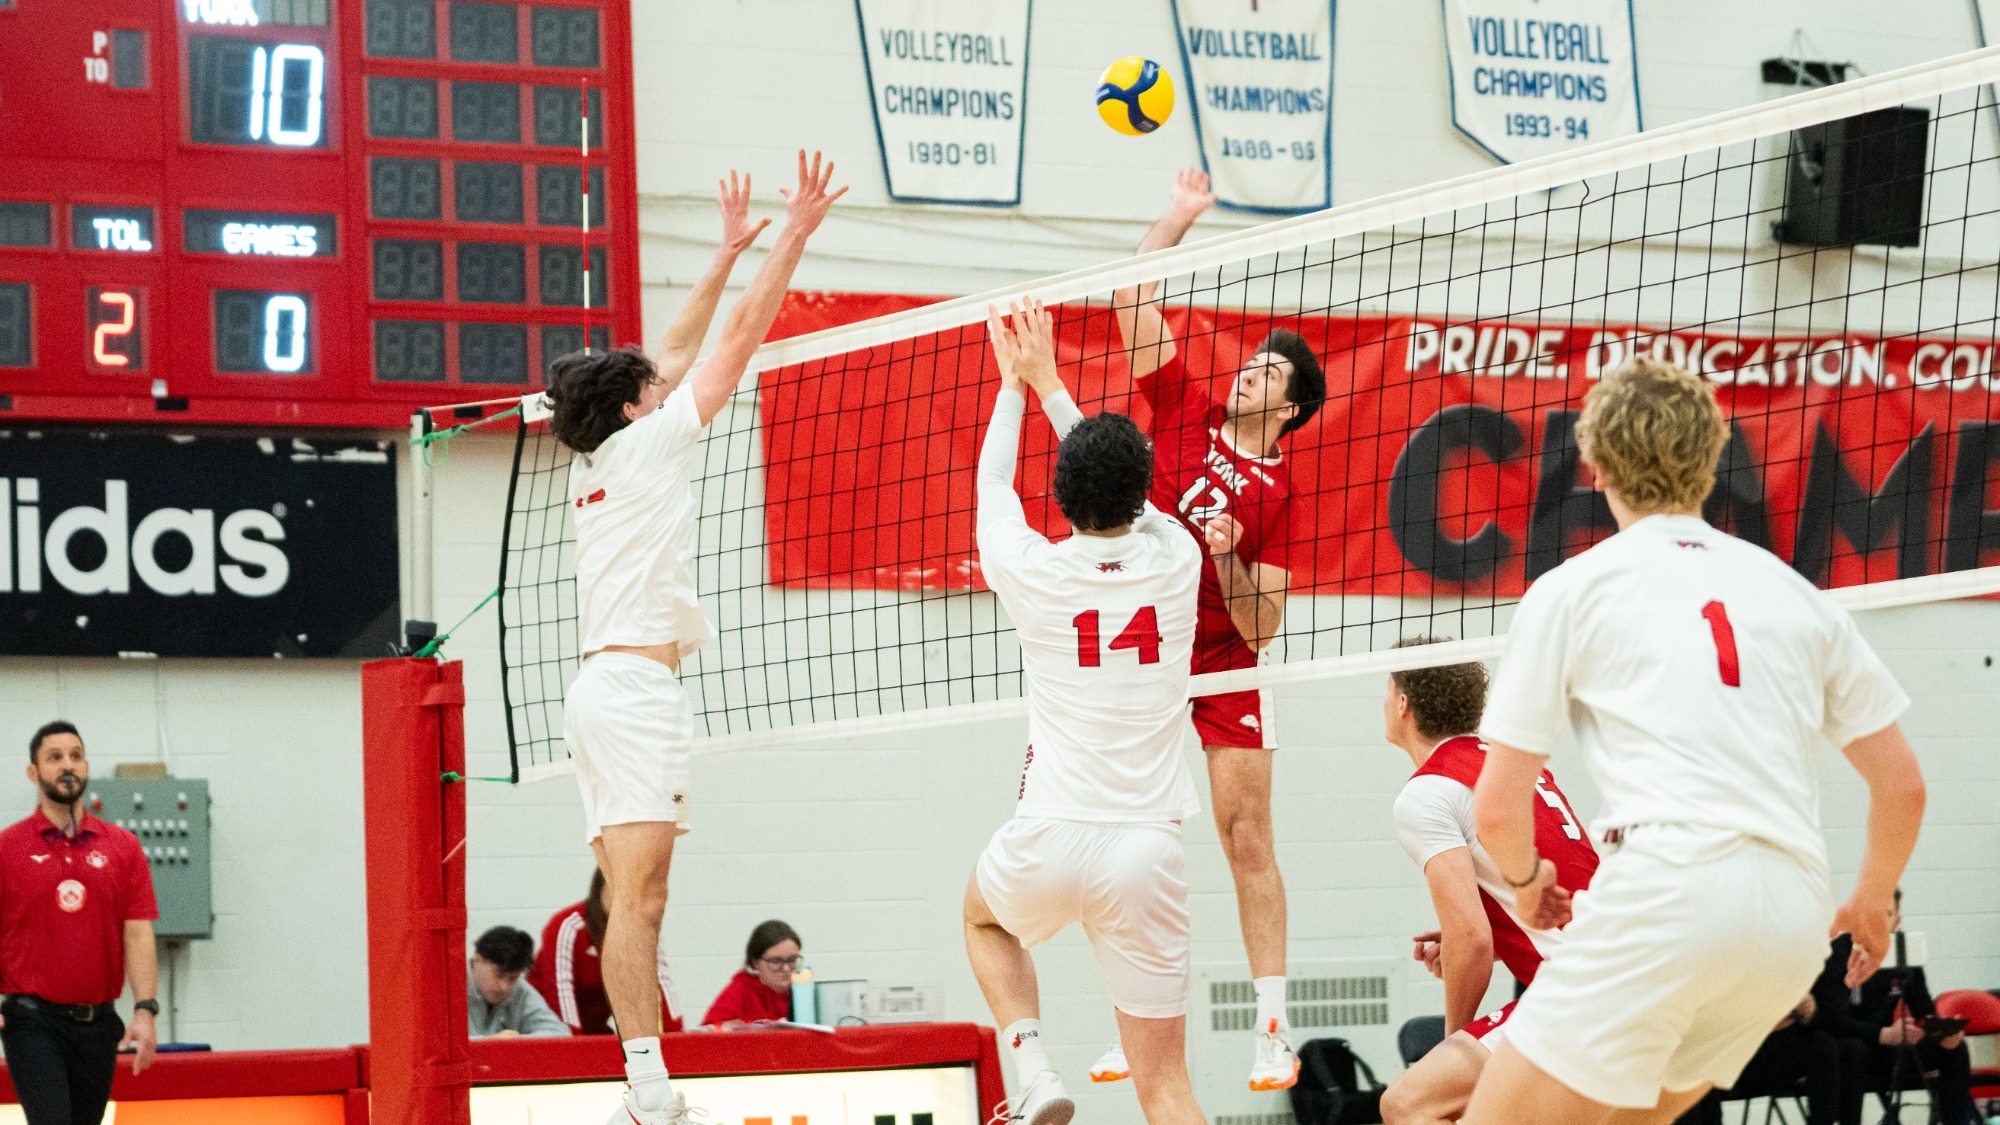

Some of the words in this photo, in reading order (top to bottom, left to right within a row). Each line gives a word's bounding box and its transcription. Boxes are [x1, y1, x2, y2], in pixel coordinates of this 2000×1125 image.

[880, 28, 1014, 66] VOLLEYBALL
[1188, 26, 1322, 61] VOLLEYBALL
[1469, 16, 1610, 64] VOLLEYBALL
[250, 44, 325, 146] 10
[884, 84, 1014, 120] CHAMPIONS
[1474, 66, 1608, 103] CHAMPIONS
[909, 141, 997, 165] 1980-81
[1505, 113, 1589, 140] 1993-94
[93, 218, 152, 251] TOL
[222, 222, 317, 257] GAMES
[94, 292, 135, 366] 2
[264, 295, 306, 371] 0
[1405, 322, 1567, 379] PRIDE.
[1586, 330, 1896, 388] DEDICATION.
[1203, 443, 1249, 496] YORK
[1178, 476, 1228, 534] 12
[0, 477, 290, 597] idas
[1072, 605, 1163, 667] 14
[1701, 599, 1741, 688] 1
[1535, 775, 1582, 841] 5
